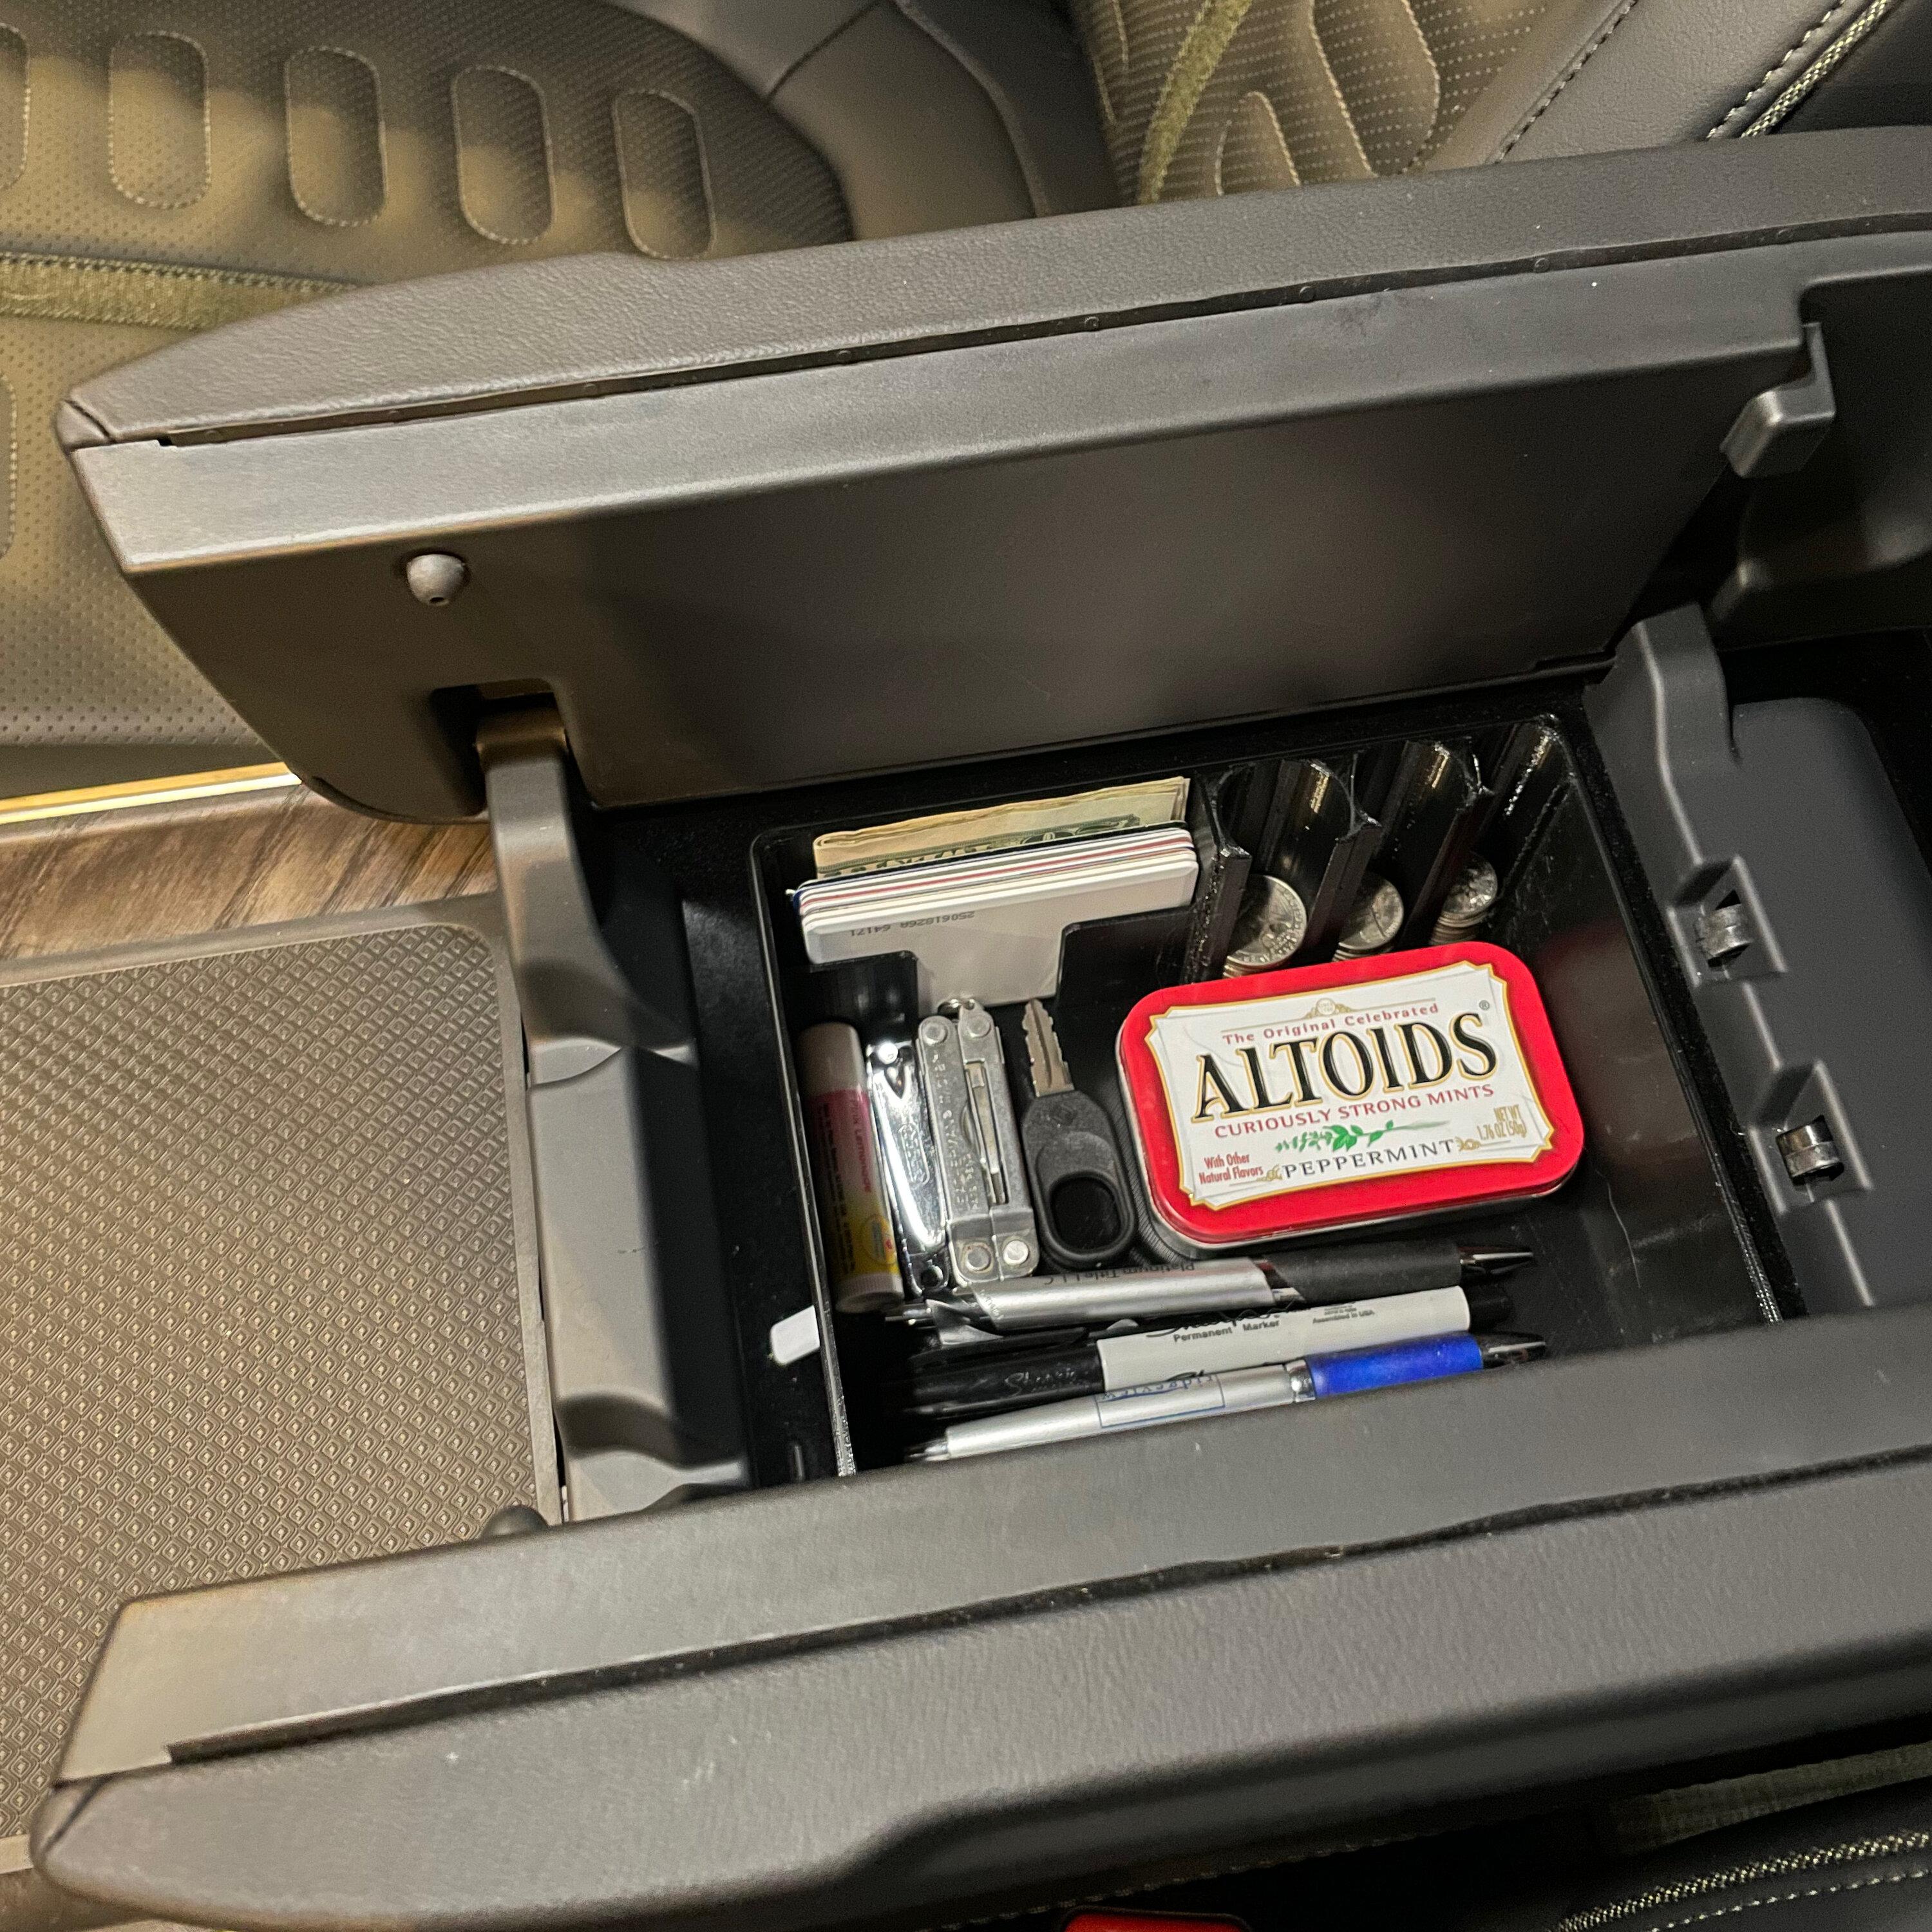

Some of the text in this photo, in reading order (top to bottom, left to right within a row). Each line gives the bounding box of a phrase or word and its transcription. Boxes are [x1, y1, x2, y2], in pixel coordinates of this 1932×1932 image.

[1222, 1032, 1255, 1045] The
[1263, 1018, 1336, 1039] Original
[1345, 1003, 1439, 1026] Celebrated
[1215, 1084, 1494, 1138] CURIOUSLY STRONG MINTS
[1493, 1104, 1521, 1121] NET WT
[1477, 1119, 1527, 1141] 1.76 OZ (50g)
[1204, 1152, 1250, 1170] With Other
[1282, 1139, 1454, 1179] PEPPERMINT
[1198, 1165, 1264, 1184] Natural Flavors
[1122, 1262, 1195, 1274] Platinum
[1173, 1327, 1233, 1342] Permanent
[1242, 1319, 1280, 1332] Marker
